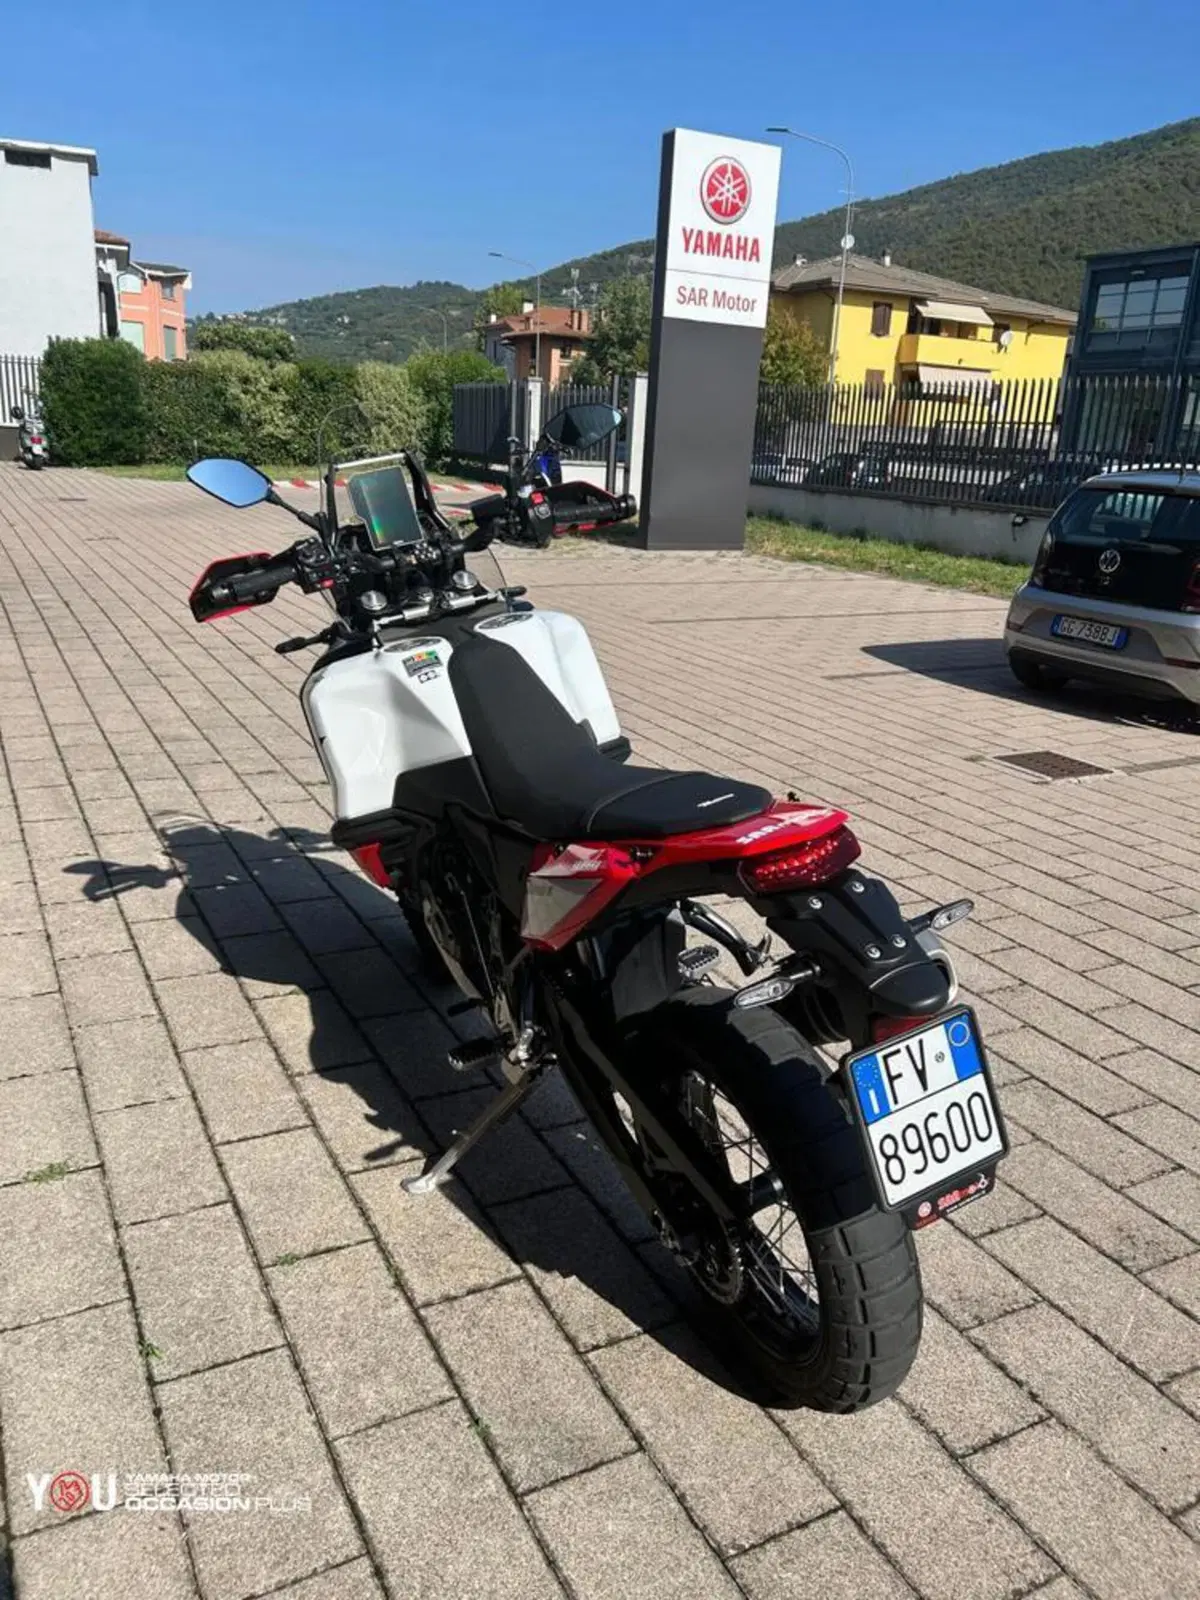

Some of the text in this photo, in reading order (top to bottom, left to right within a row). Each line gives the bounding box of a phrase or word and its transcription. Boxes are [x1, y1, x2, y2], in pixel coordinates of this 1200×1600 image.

[682, 226, 760, 263] YAMAHA
[677, 285, 758, 312] SAR Motor
[882, 1038, 929, 1105] FV
[878, 1091, 993, 1185] 89600
